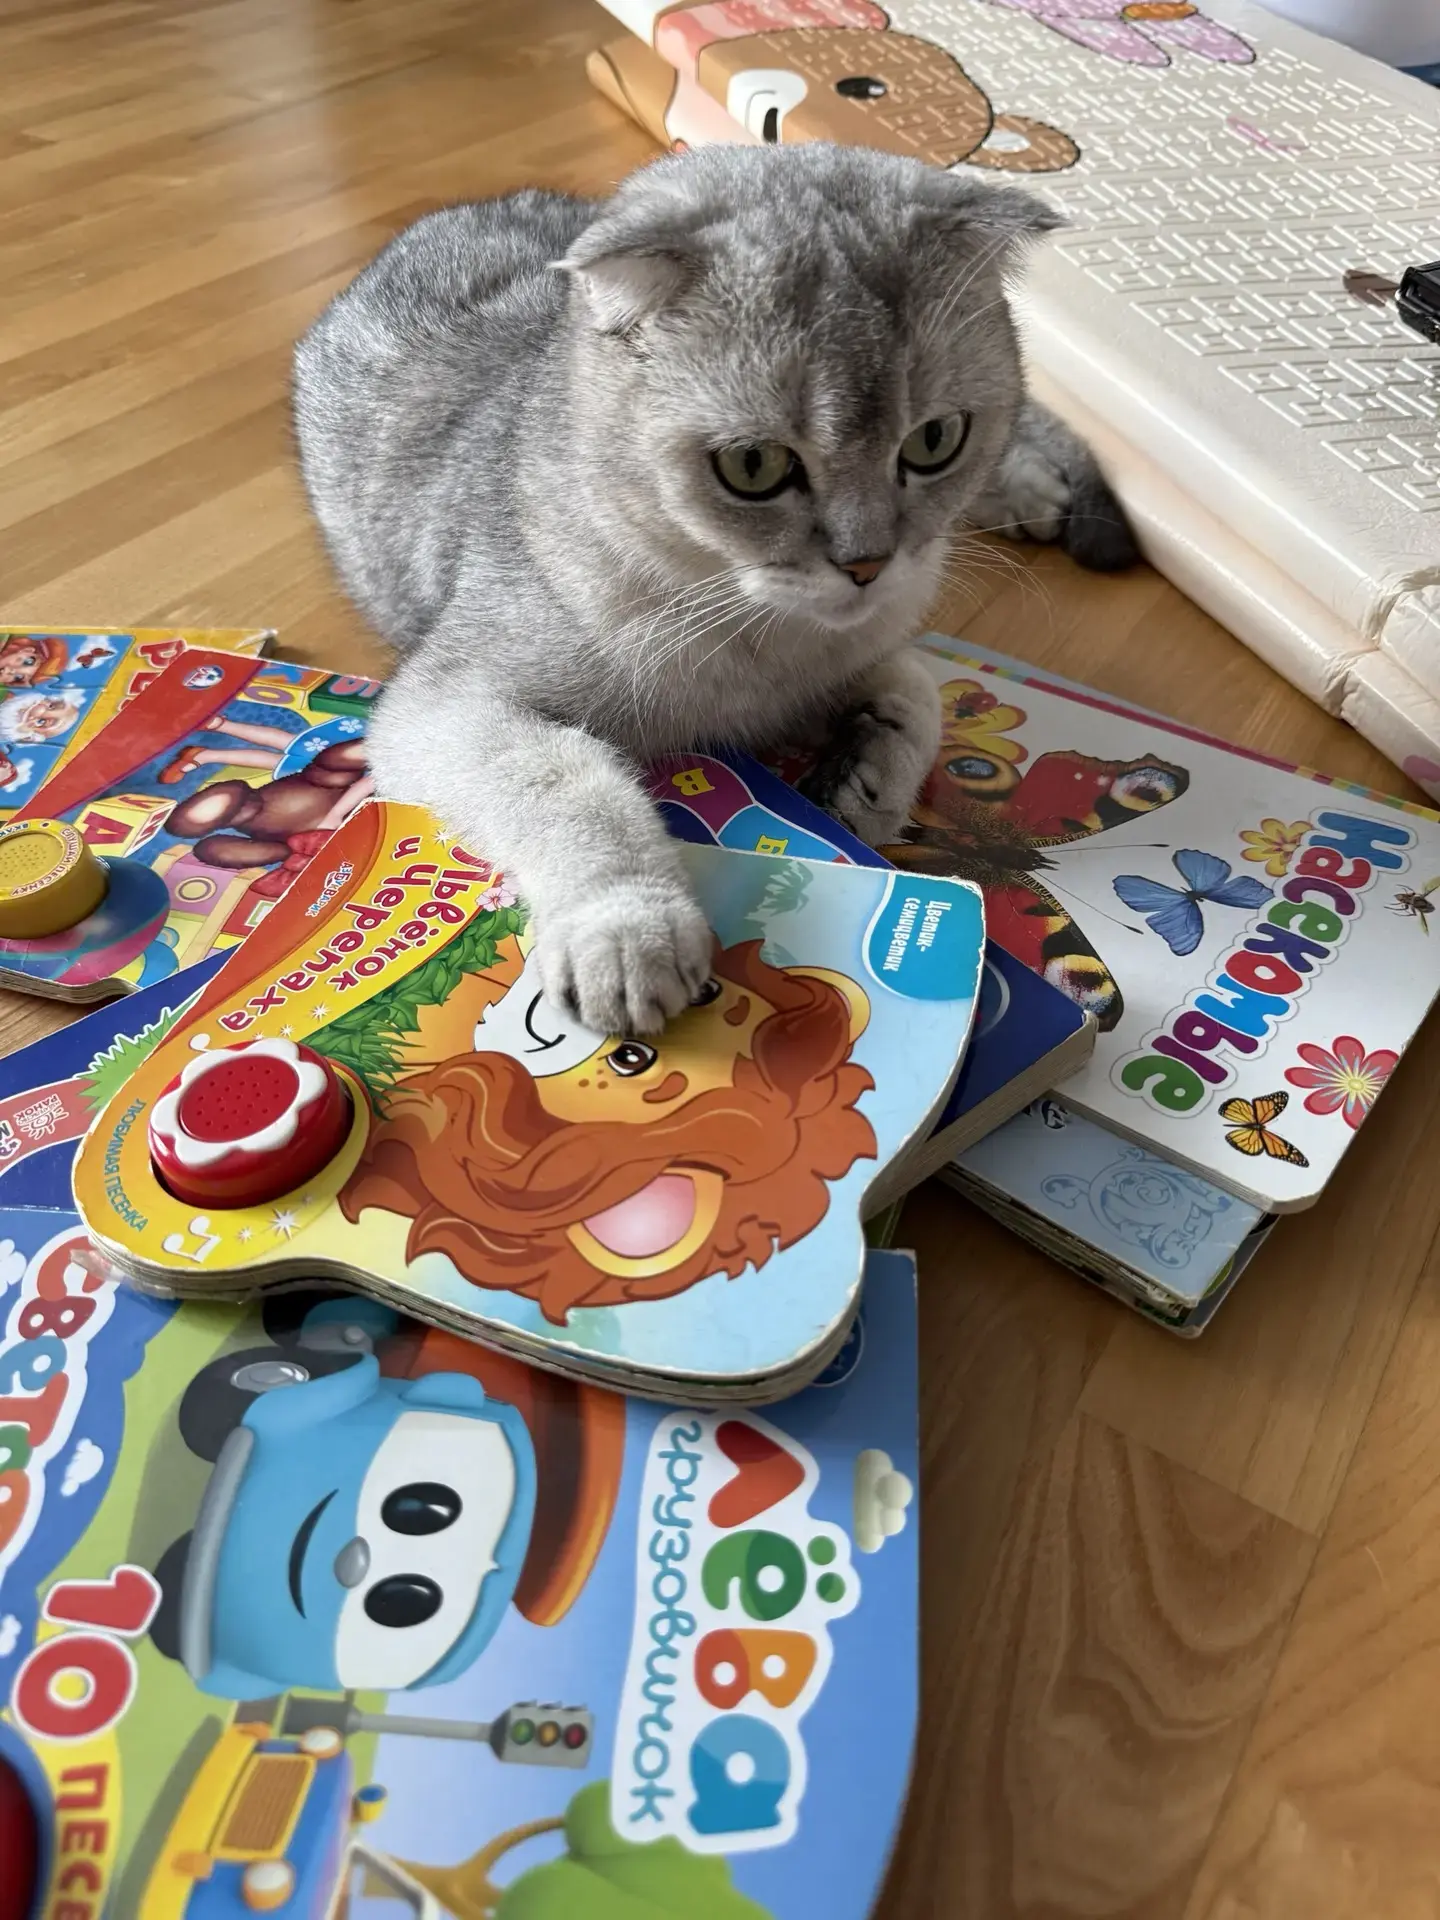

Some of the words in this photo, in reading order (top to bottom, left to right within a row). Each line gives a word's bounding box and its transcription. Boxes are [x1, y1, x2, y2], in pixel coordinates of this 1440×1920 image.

[60, 827, 79, 864] СЛУШАЙ
[392, 836, 422, 860] и
[11, 864, 66, 896] ПЕСЕНКУ
[305, 861, 353, 917] АЗБУКВАРИК
[219, 863, 440, 1032] Черепаха
[328, 845, 491, 992] Львёнок
[883, 897, 920, 972] семицветик
[916, 900, 952, 952] Цветик-
[1121, 811, 1412, 1112] Насекомые
[16, 1094, 58, 1121] РАНОК
[104, 1098, 146, 1176] ЛЮБИМАЯ
[105, 1177, 149, 1232] ПЕСЕНКА
[15, 1567, 160, 1740] 10
[628, 1421, 703, 1823] грузовичок
